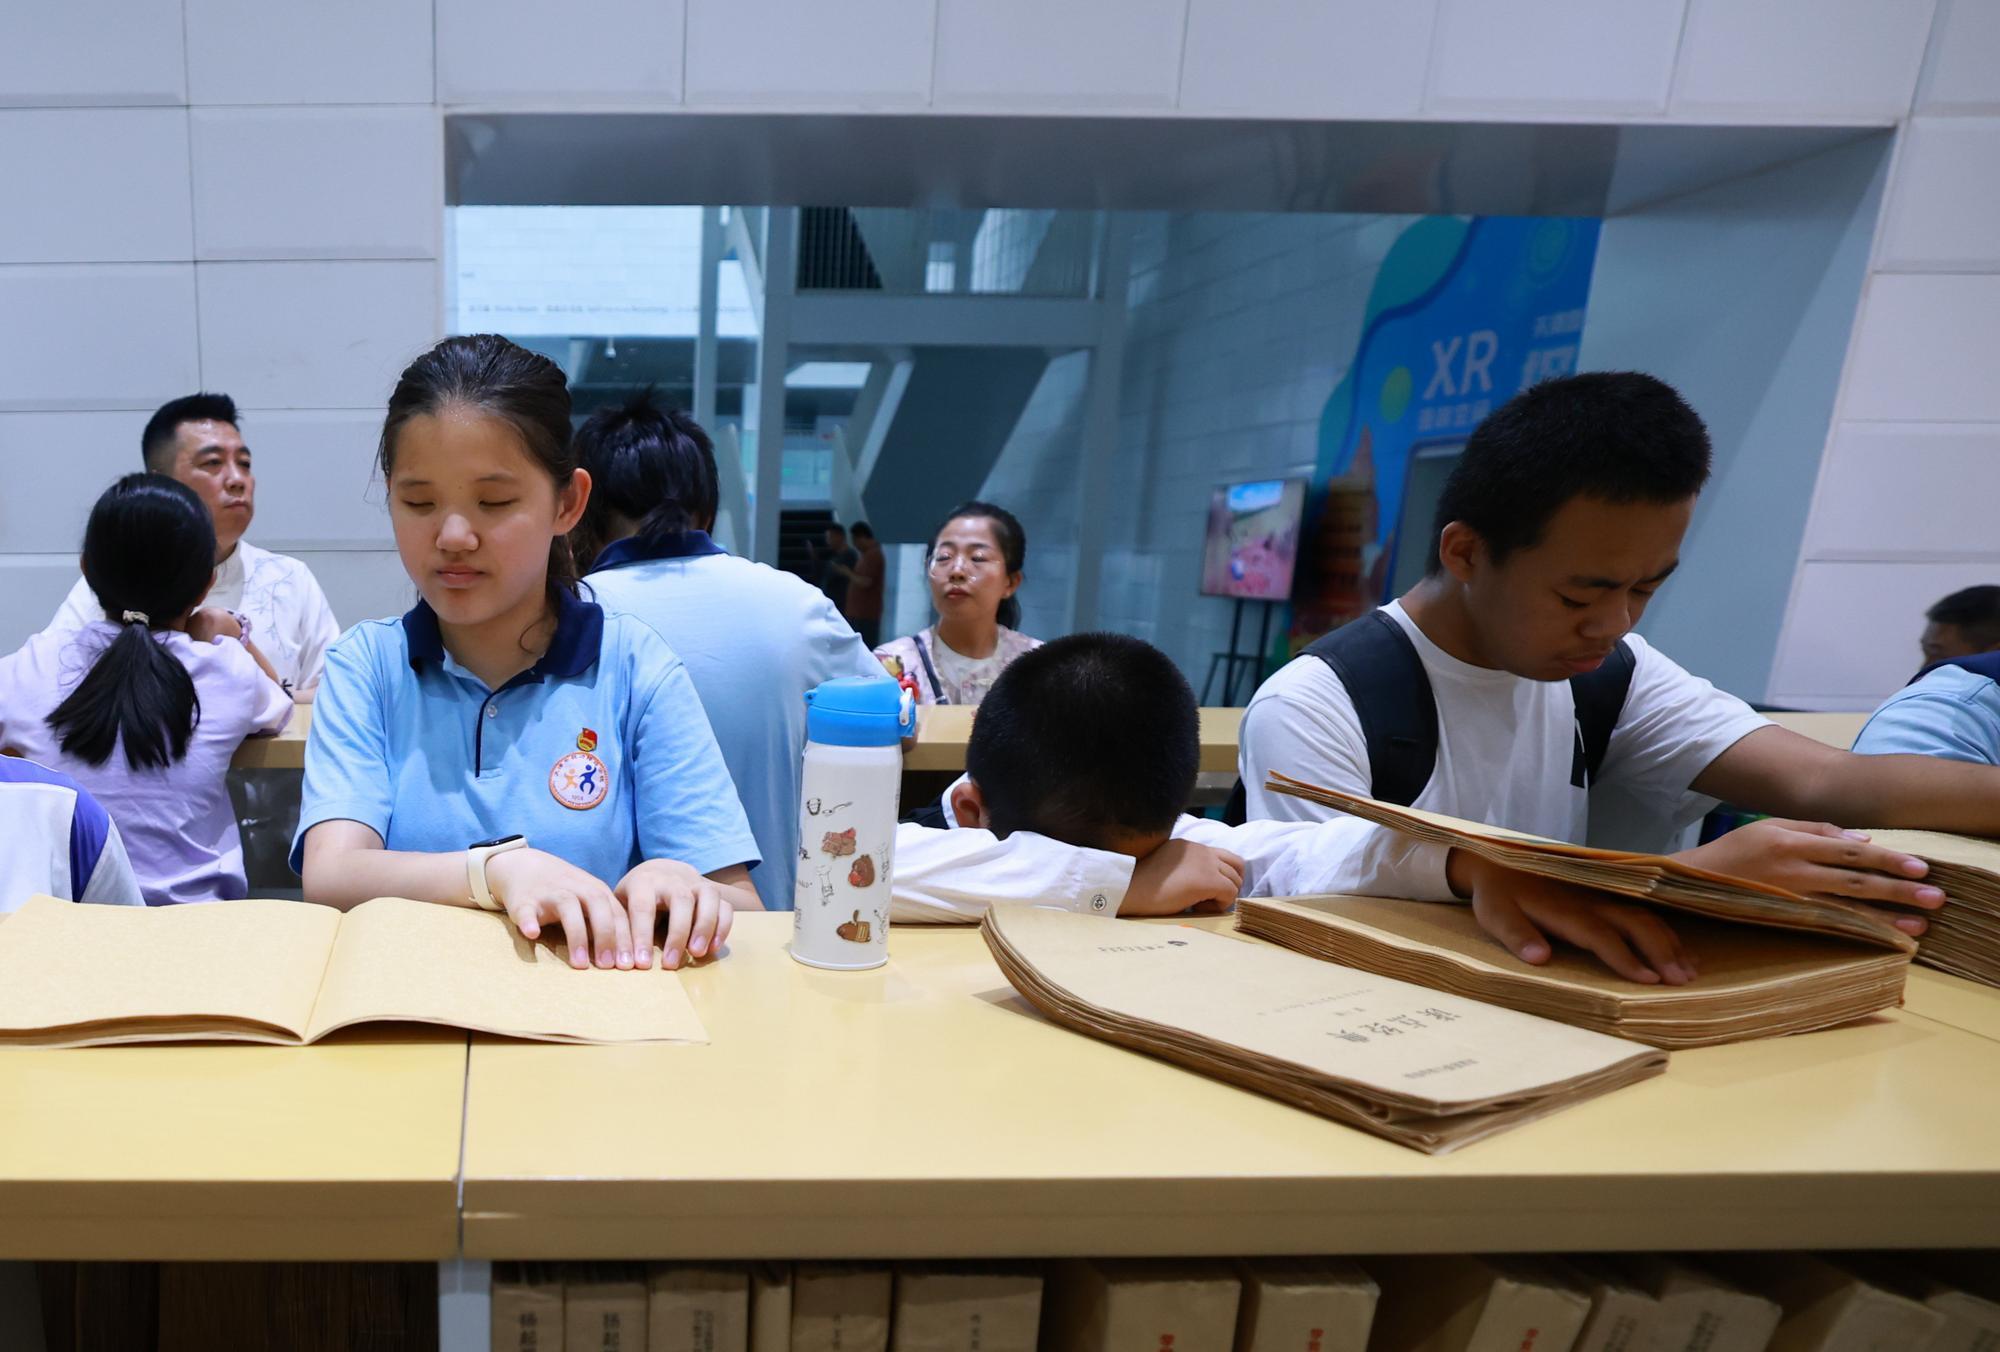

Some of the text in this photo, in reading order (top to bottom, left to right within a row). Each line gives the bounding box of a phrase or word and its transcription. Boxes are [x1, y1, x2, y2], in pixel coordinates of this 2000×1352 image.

[1422, 329, 1499, 400] XR
[1326, 1007, 1462, 1045] 读点经典
